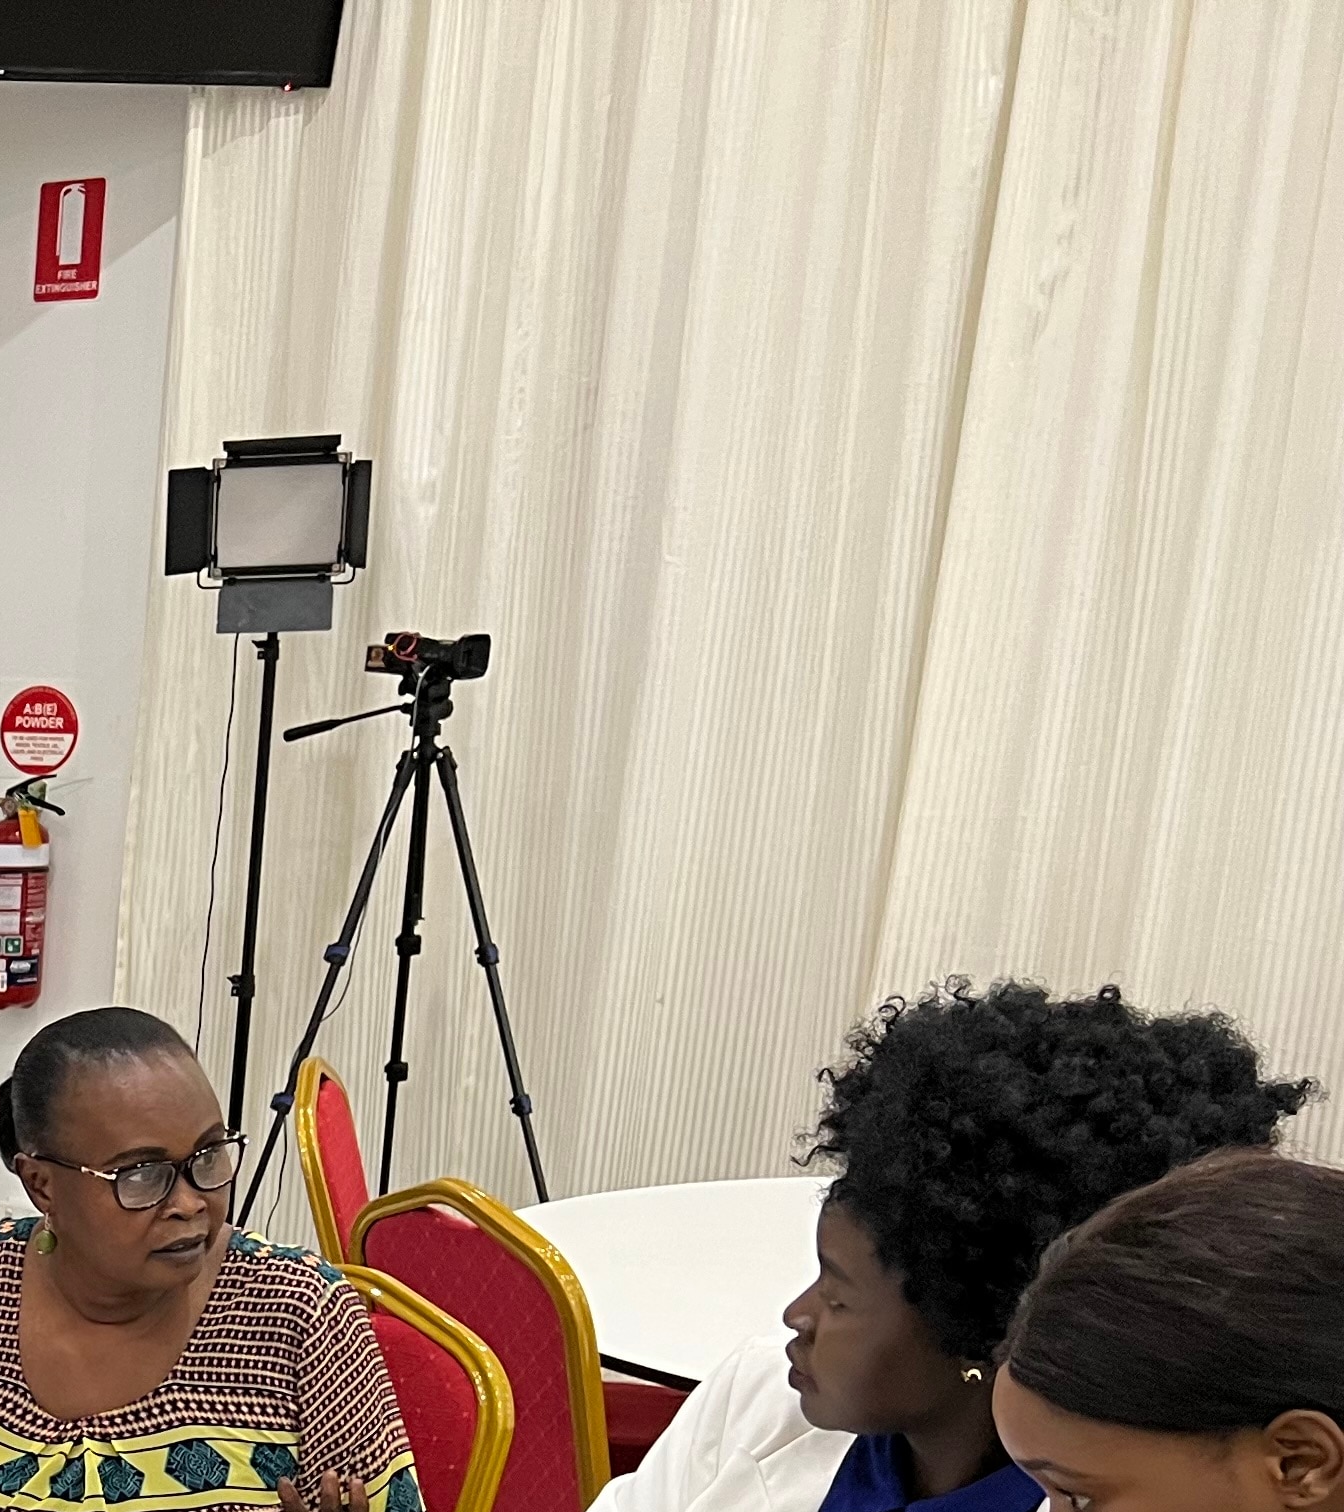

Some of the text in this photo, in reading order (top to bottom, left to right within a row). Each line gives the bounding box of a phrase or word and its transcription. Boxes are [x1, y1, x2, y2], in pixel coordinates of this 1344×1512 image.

[57, 269, 78, 280] FIRE
[35, 281, 97, 294] EXTINGUISHER
[15, 716, 64, 729] POWDER
